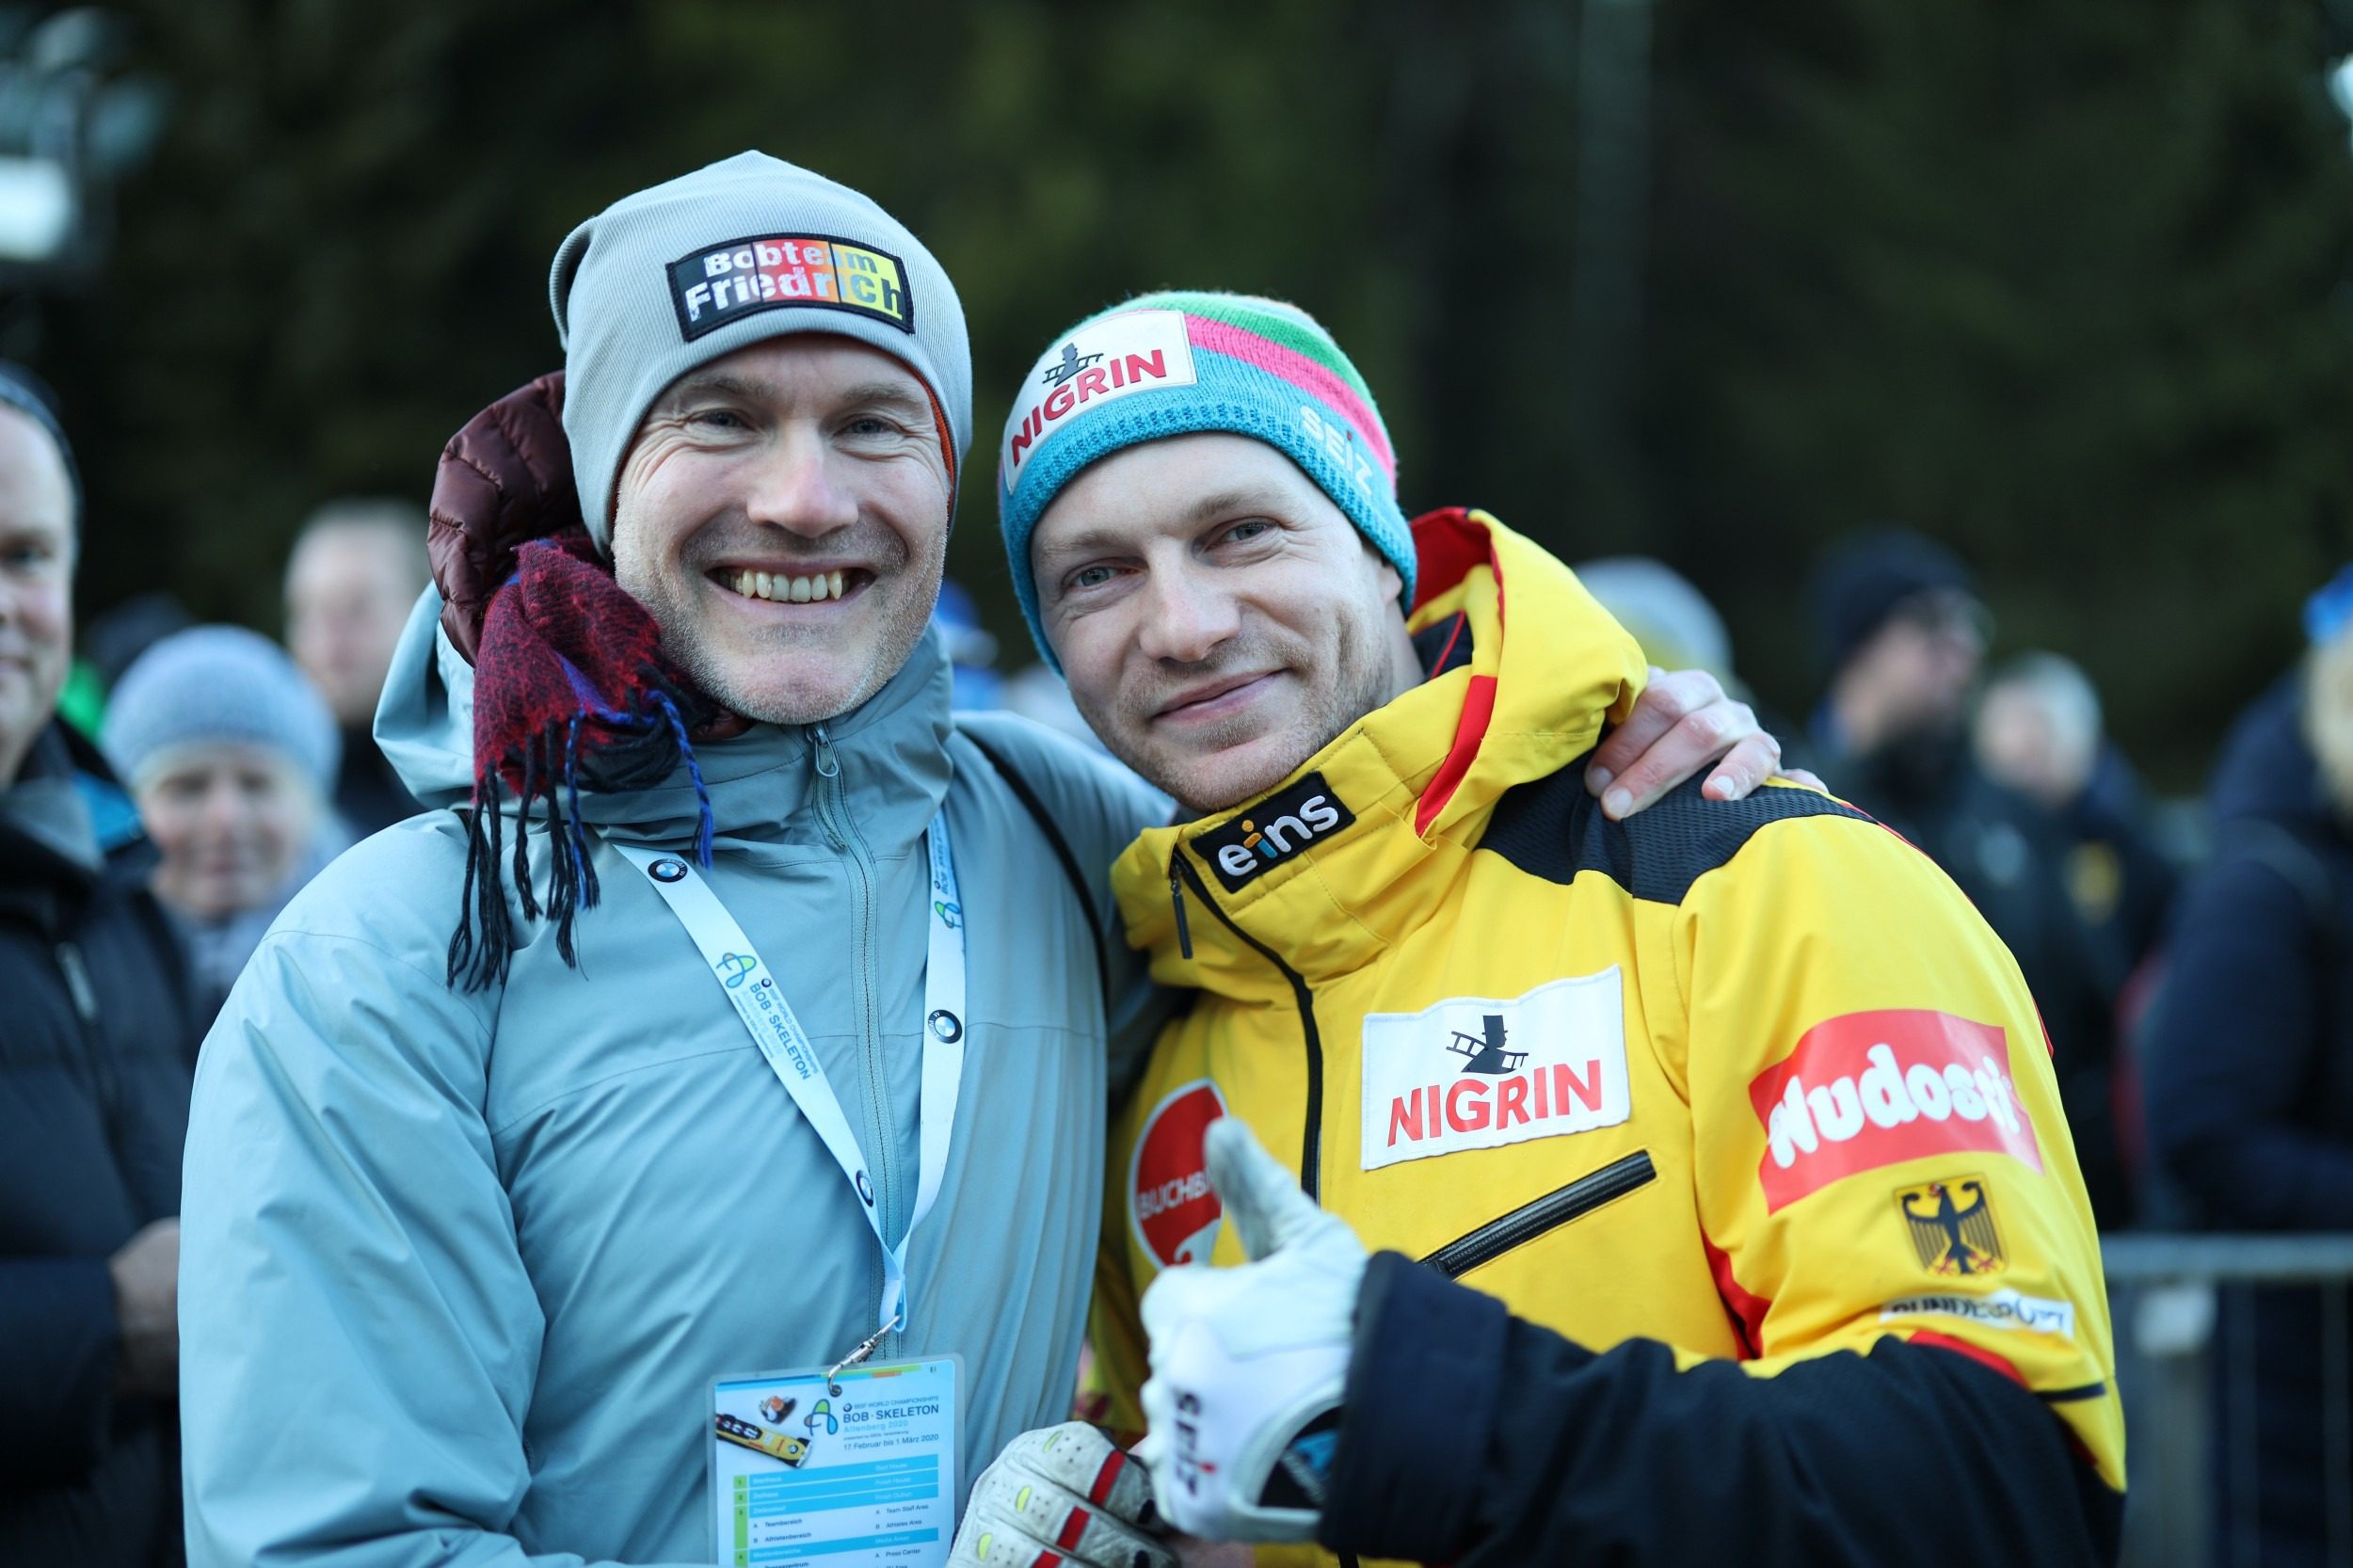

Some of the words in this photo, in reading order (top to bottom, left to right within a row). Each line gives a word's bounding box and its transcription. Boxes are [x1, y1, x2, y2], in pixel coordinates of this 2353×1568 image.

[703, 242, 878, 278] Bobteam
[684, 267, 903, 322] Friedrich
[1012, 349, 1167, 467] NIGRIN
[1218, 794, 1338, 876] eins
[749, 983, 772, 1010] BOB
[769, 1015, 811, 1080] SKELETON
[1386, 1059, 1602, 1147] NIGRIN
[843, 1412, 870, 1423] BOB
[875, 1404, 939, 1420] SKELETON
[854, 1440, 881, 1449] Februar
[902, 1435, 920, 1445] März
[920, 1433, 939, 1443] 2020
